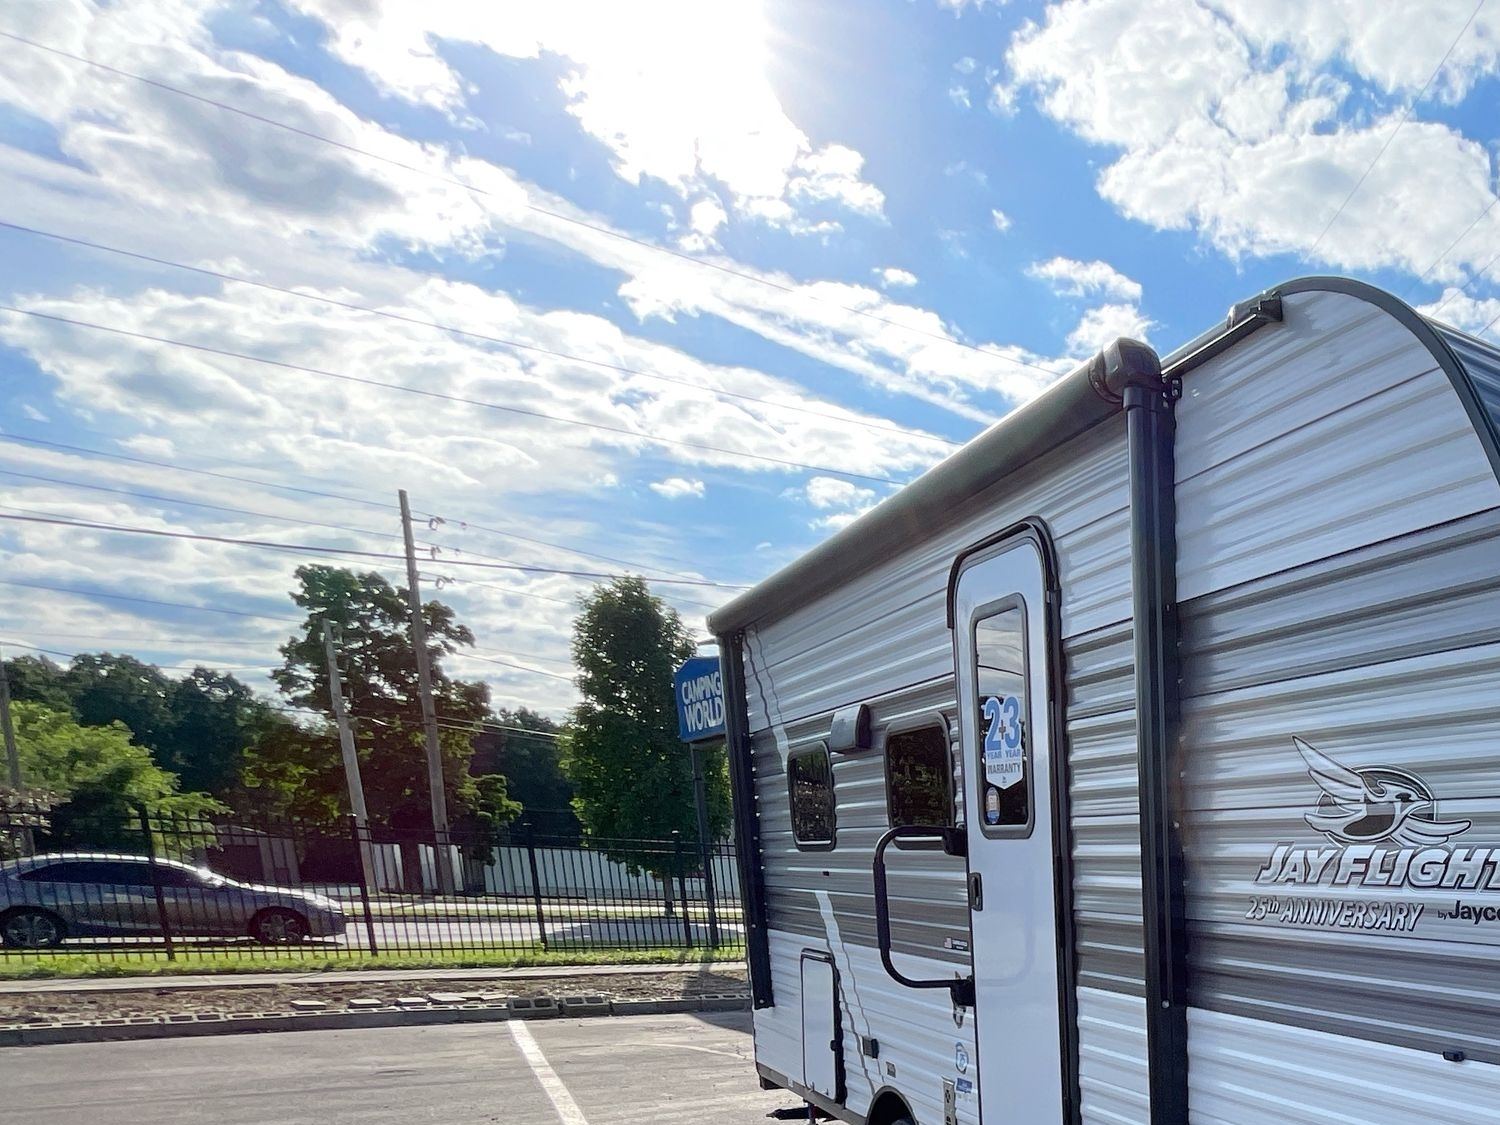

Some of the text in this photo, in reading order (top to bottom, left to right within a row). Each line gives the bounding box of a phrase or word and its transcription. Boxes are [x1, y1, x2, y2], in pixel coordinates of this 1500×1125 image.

[681, 671, 722, 705] CAMPING
[683, 697, 724, 733] WORLD
[987, 749, 1021, 760] YEAR YEAR
[987, 762, 1021, 775] WARRANTY
[1255, 841, 1335, 886] JAY
[1245, 896, 1424, 932] 25th ANNIVERSARY
[1438, 909, 1448, 921] by
